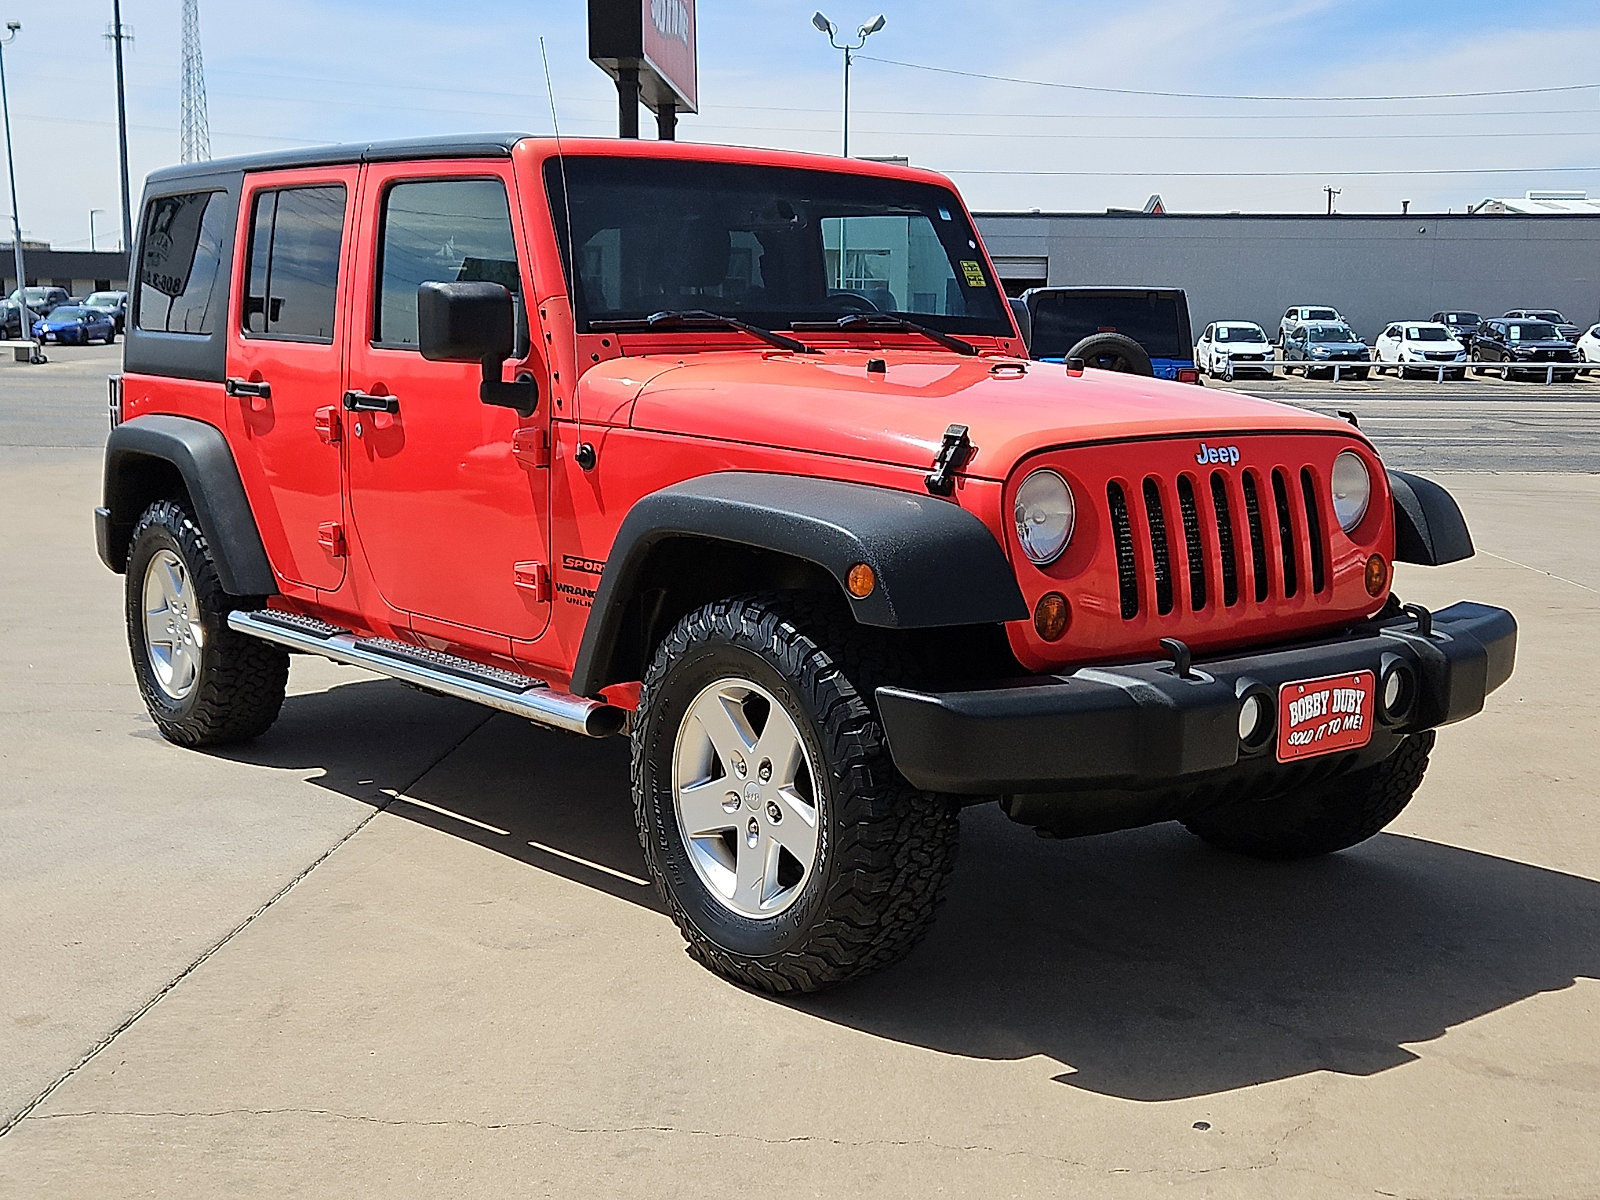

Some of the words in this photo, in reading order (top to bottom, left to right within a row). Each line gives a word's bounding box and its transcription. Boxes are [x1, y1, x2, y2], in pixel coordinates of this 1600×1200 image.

[1196, 442, 1240, 467] Jeep
[565, 557, 606, 573] SPOR
[1288, 690, 1330, 728] BOBBY
[1332, 688, 1366, 714] DUBY
[1287, 729, 1314, 746] SOLD
[1314, 724, 1328, 742] IT
[1327, 717, 1342, 736] TO
[1342, 714, 1364, 731] ME!
